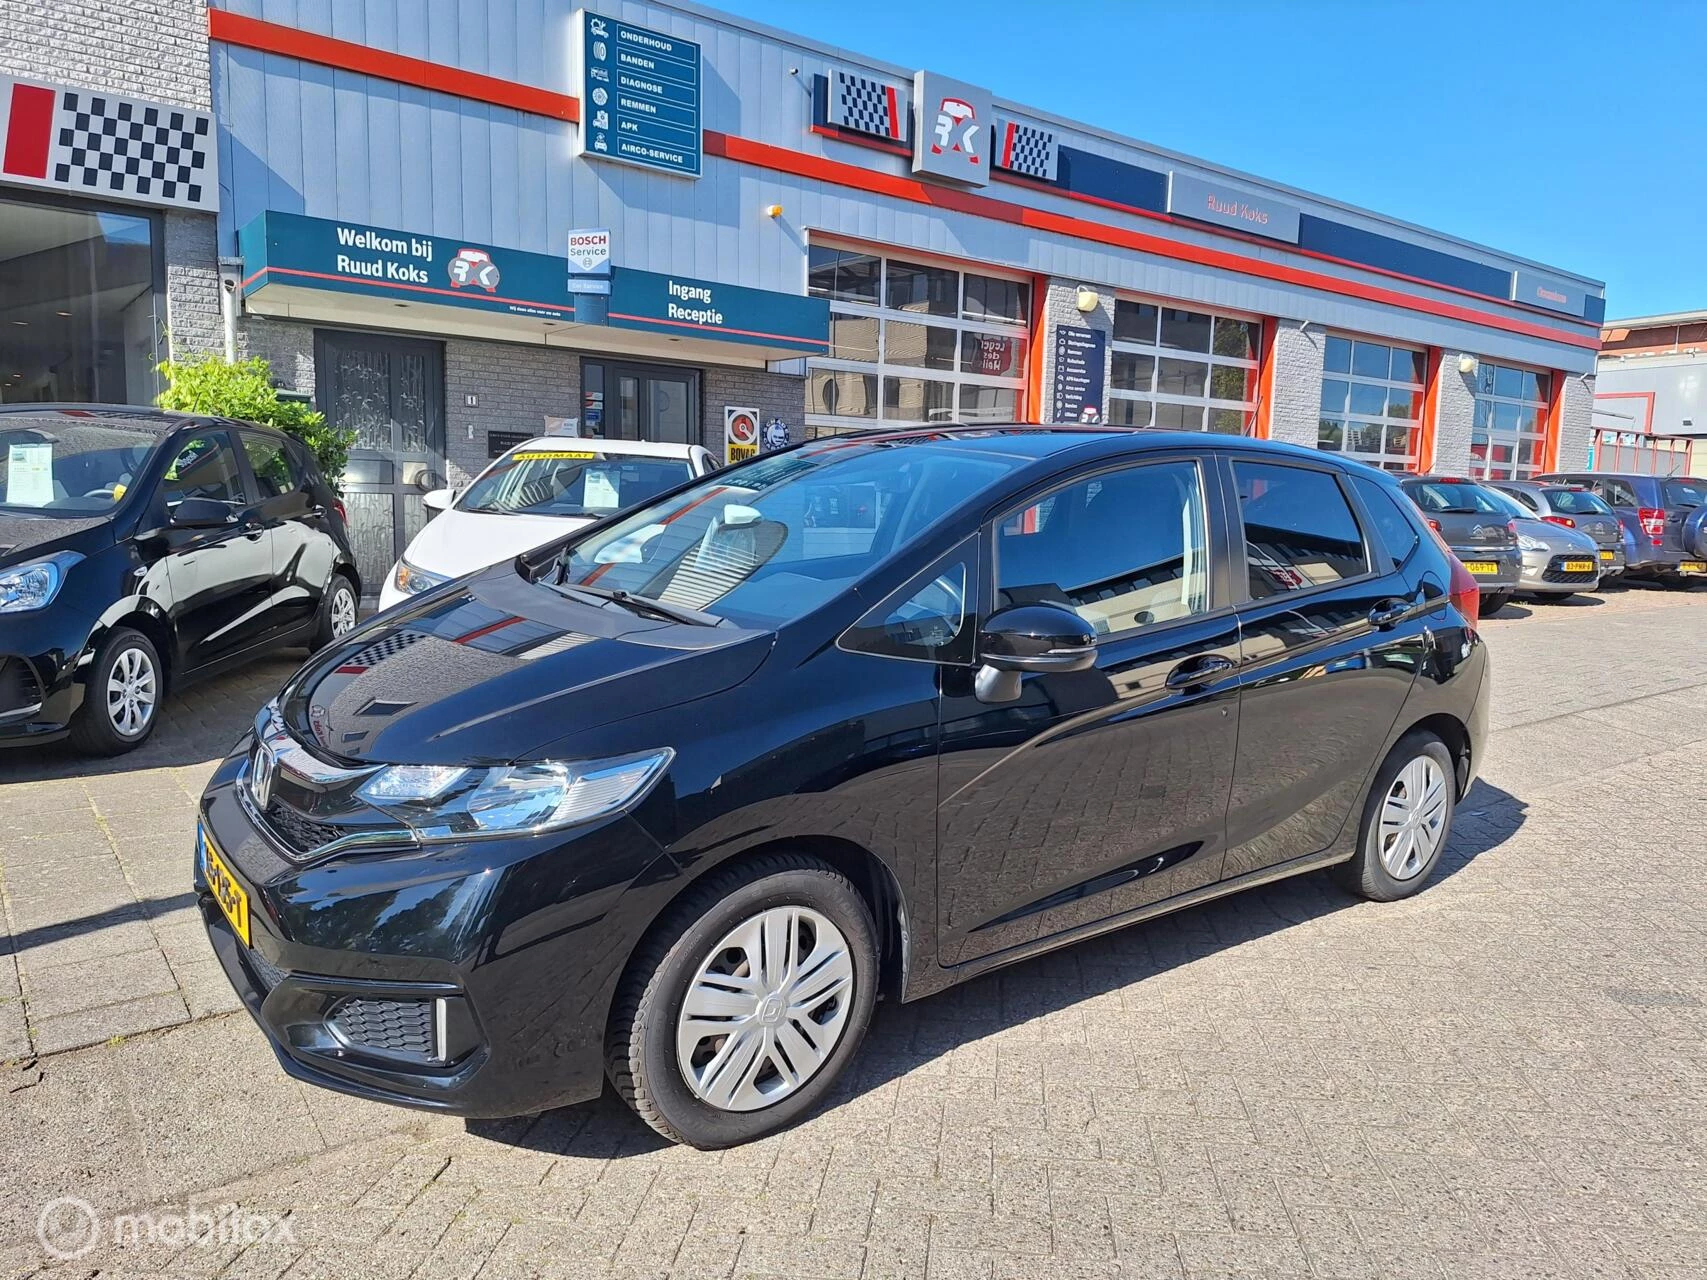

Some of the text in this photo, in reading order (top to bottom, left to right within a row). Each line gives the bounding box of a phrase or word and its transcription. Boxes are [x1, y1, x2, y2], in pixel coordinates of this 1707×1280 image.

[620, 31, 672, 51] ONDERHOUD
[620, 53, 655, 69] BANDEN
[620, 77, 663, 94] DIAGNOSE
[620, 98, 657, 113] REMMEN
[620, 122, 639, 132] APK
[621, 143, 684, 163] AIRCO-SERVICE
[1207, 192, 1268, 225] Ruud Koks
[337, 227, 433, 262] Welkom bij
[570, 235, 606, 246] BOSCH
[570, 246, 606, 256] Service
[337, 254, 428, 284] Ruud Koks
[668, 280, 711, 304] Ingang
[668, 302, 723, 325] Receptie
